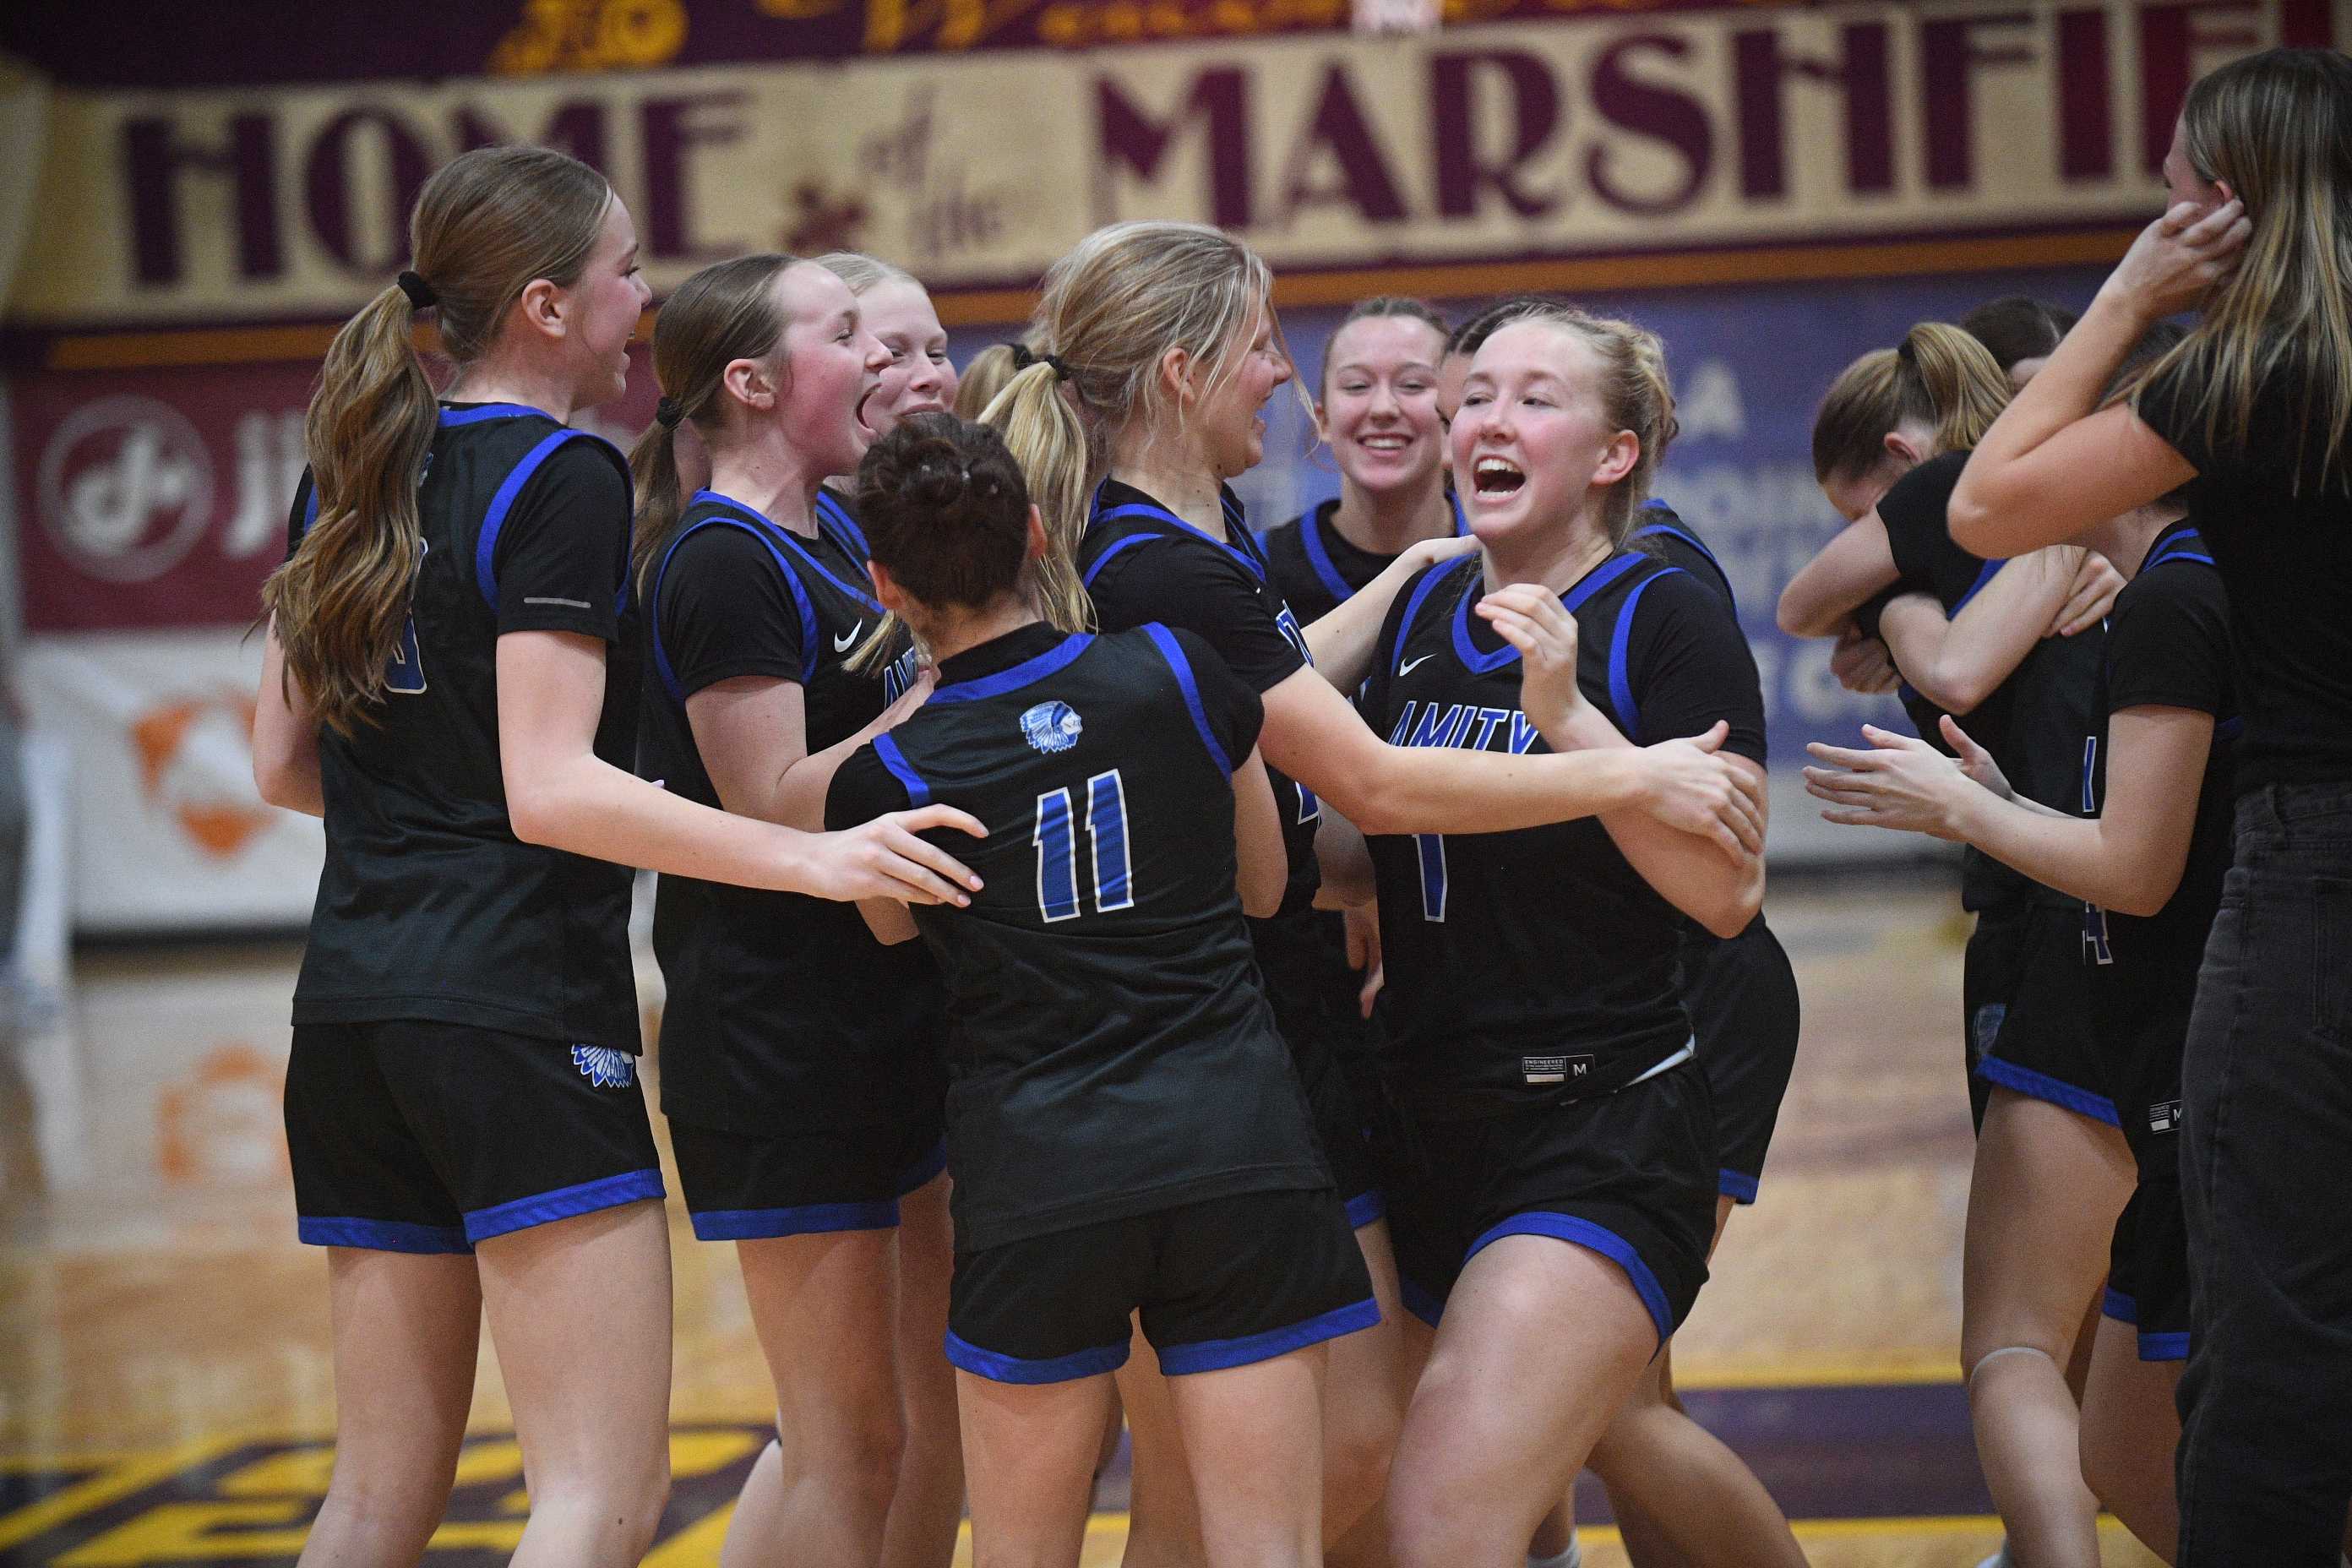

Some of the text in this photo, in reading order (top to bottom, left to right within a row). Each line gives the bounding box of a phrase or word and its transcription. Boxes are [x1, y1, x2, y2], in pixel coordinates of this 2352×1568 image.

[1092, 0, 2335, 228] MARSHFIE
[1388, 700, 1538, 754] AMITY
[1032, 768, 1135, 923] 11
[1573, 1063, 1587, 1076] M
